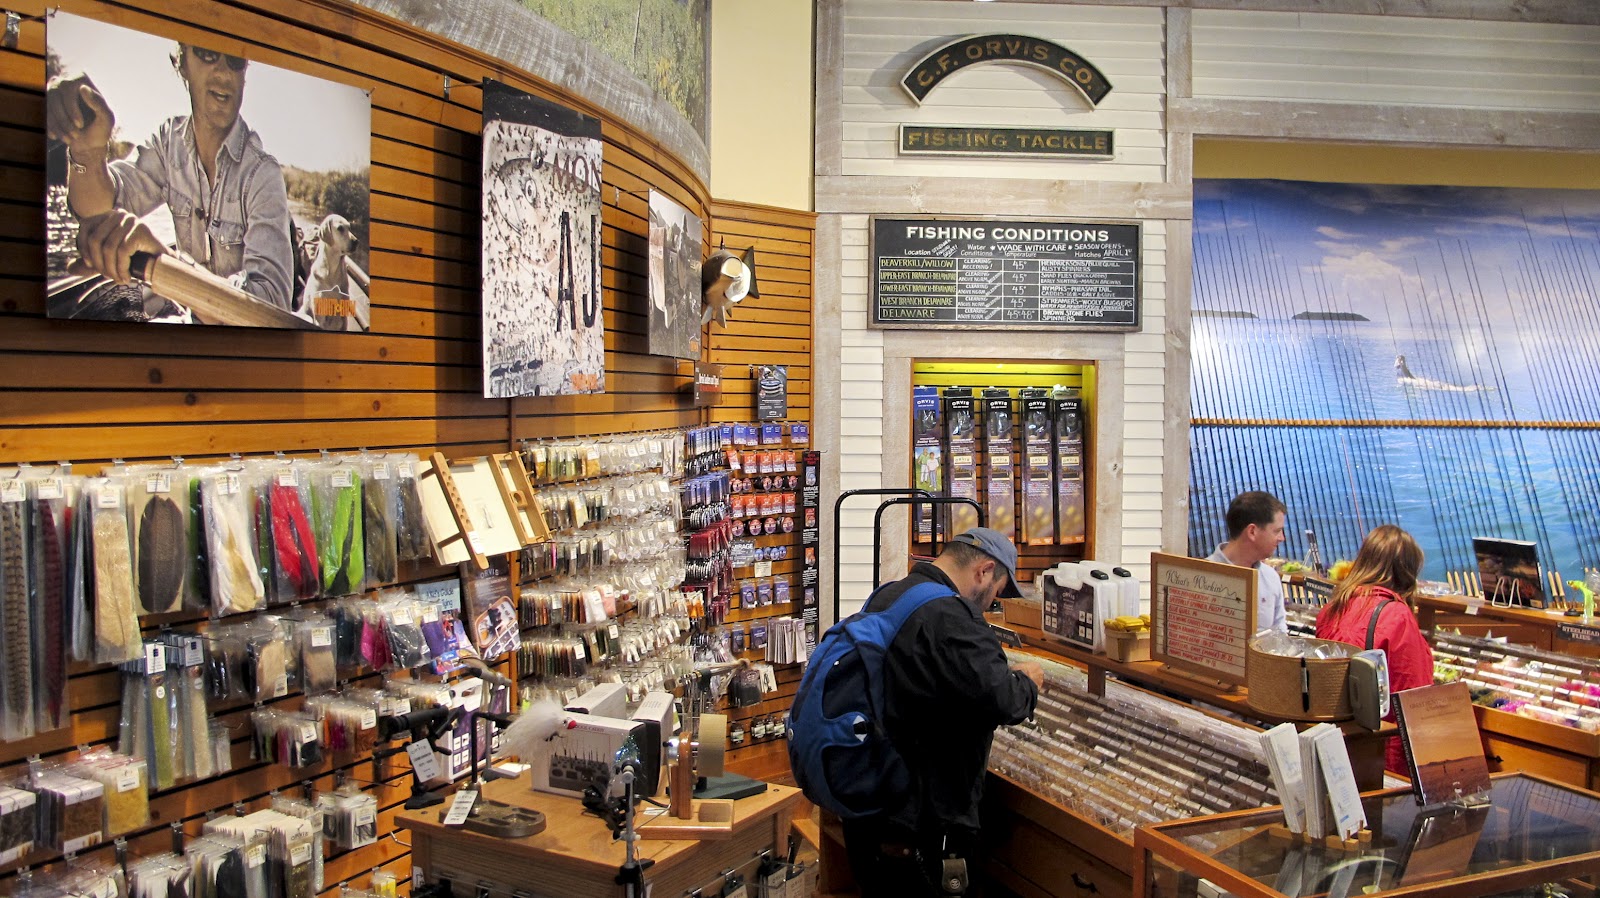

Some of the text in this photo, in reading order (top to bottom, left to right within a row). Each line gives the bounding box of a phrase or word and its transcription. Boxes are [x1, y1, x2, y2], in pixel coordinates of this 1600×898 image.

[916, 40, 1093, 91] C.F. ORVIS CO.
[908, 130, 1107, 151] FISHING TACKLE
[906, 226, 1109, 242] FISHING CONDITIONS
[997, 244, 1022, 252] WADE
[1046, 245, 1067, 253] CARE
[1004, 252, 1037, 260] Temperature
[882, 309, 936, 318] DELAWARE
